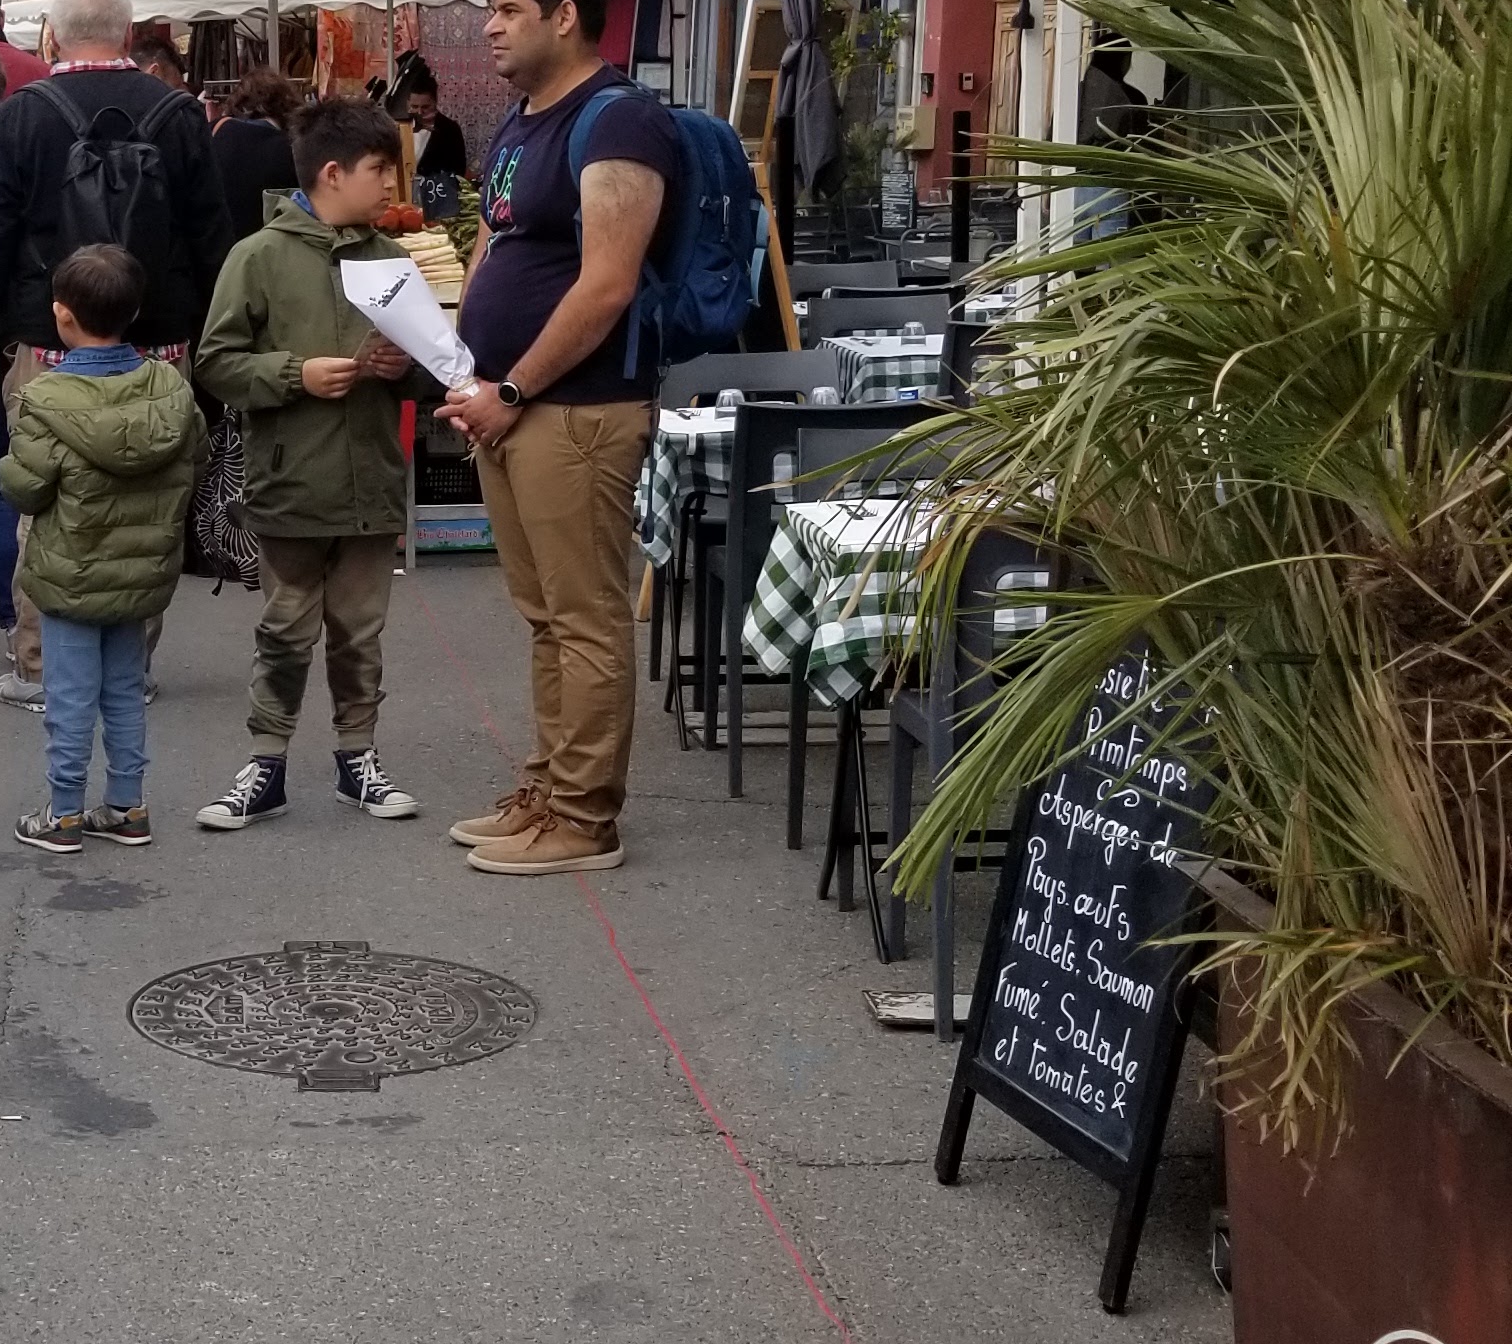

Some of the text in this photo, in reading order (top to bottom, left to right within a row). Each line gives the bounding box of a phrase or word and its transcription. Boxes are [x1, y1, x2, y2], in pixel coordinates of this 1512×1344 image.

[1039, 774, 1178, 869] Asperges de
[1088, 939, 1155, 1014] Saumon
[995, 1026, 1019, 1066] et
[1028, 1039, 1106, 1113] tomates
[1056, 993, 1138, 1084] Salade
